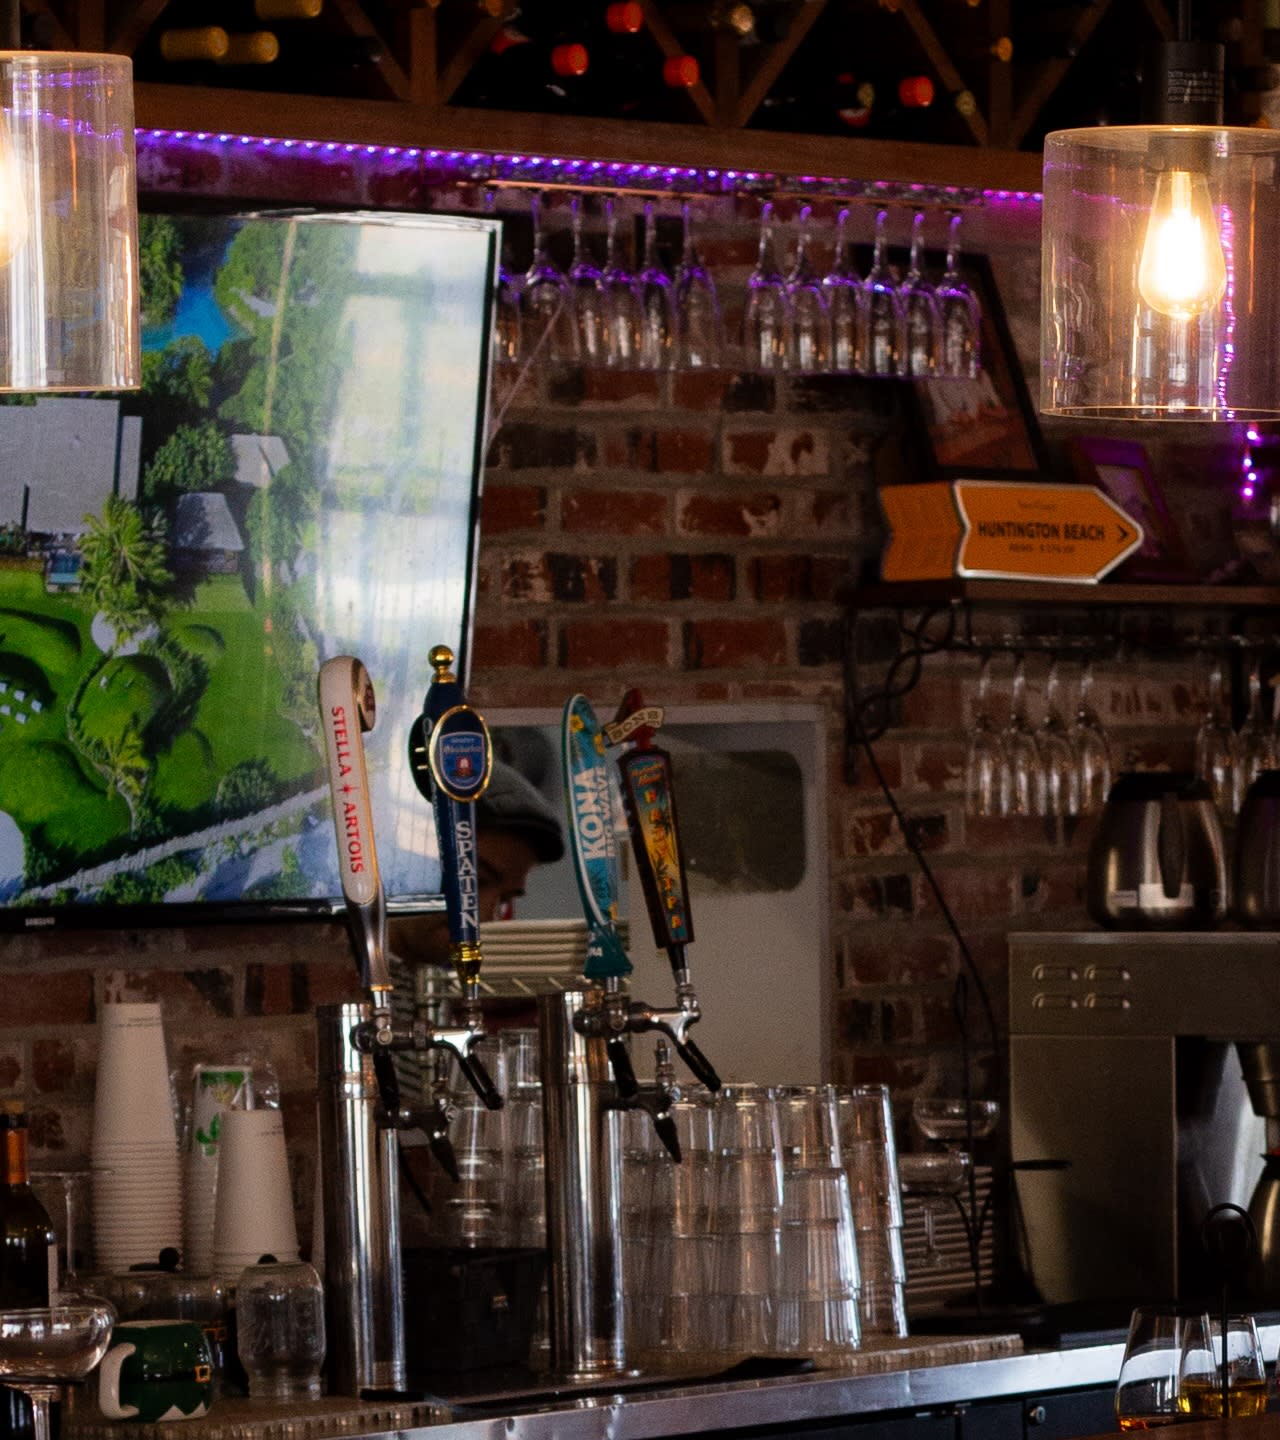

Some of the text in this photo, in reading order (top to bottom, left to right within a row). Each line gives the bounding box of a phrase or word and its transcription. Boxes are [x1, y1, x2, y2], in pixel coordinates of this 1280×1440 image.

[978, 521, 1105, 541] HUNTINGTON BEACH
[332, 706, 353, 777] STELLA
[343, 801, 365, 874] ARTOIS
[575, 766, 607, 860] KONA
[455, 820, 479, 930] SPATEN
